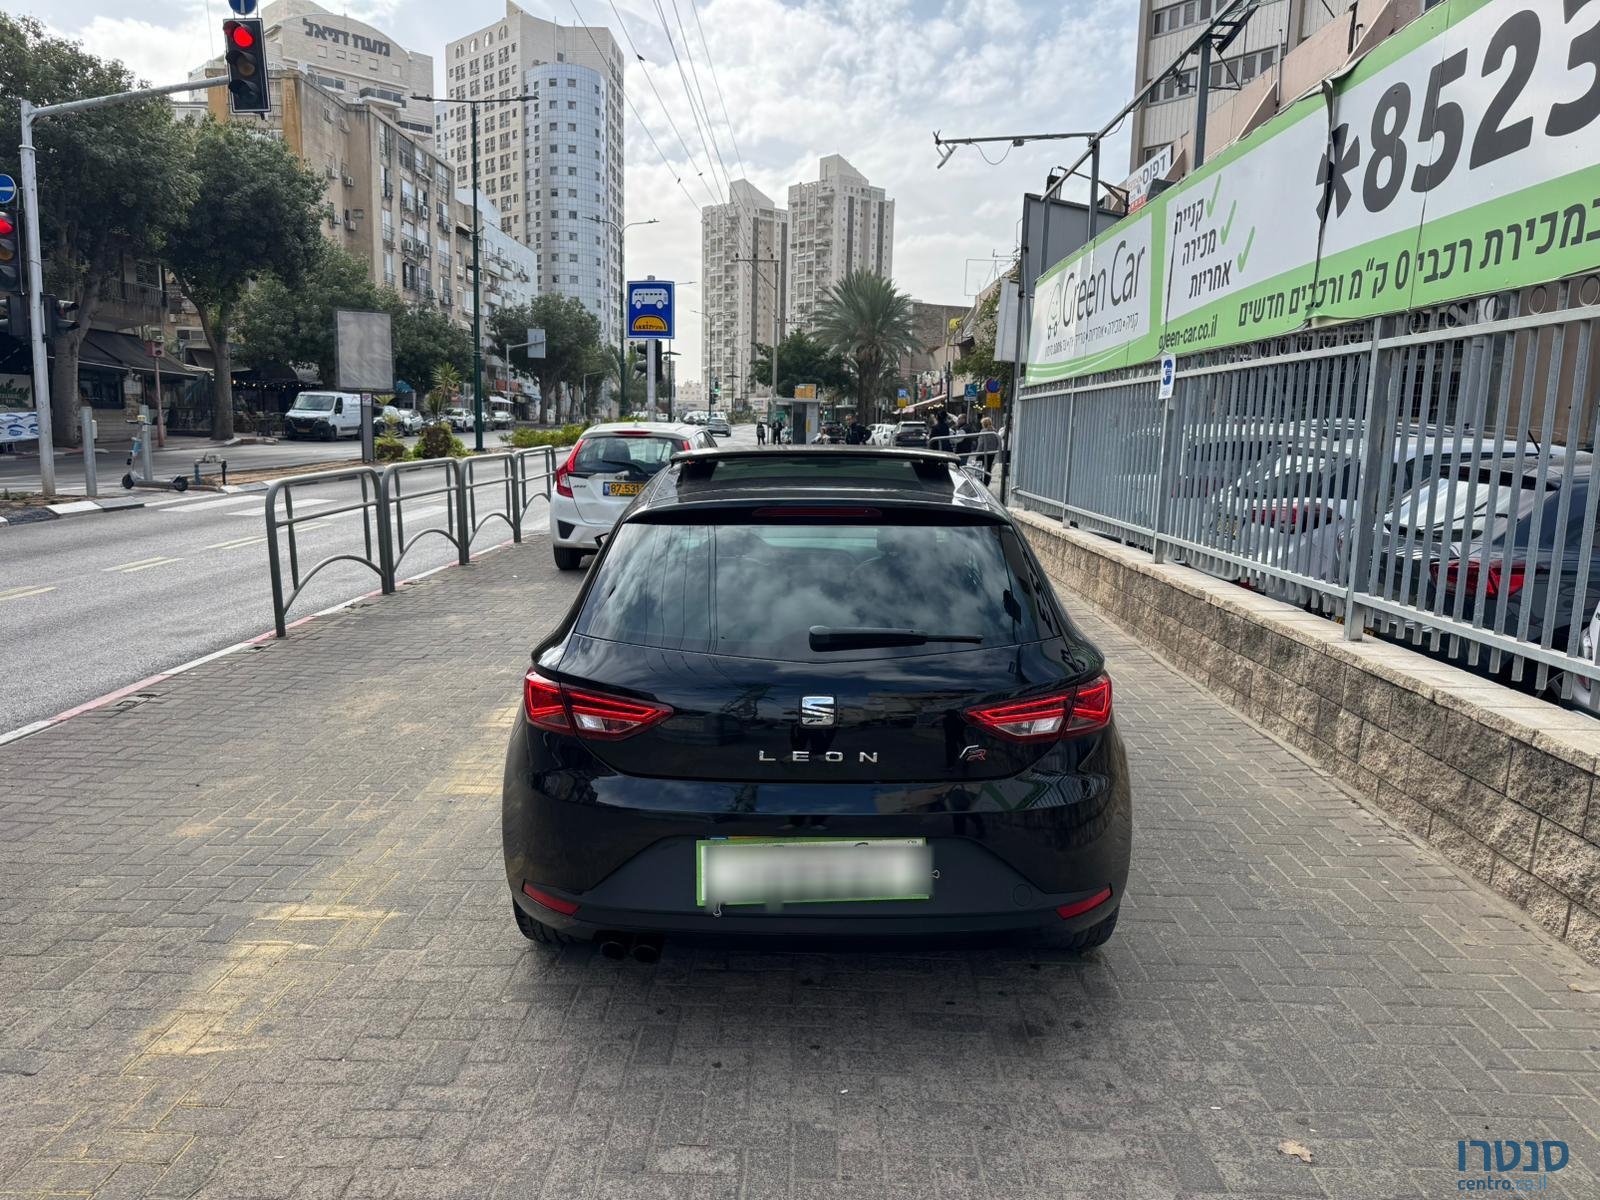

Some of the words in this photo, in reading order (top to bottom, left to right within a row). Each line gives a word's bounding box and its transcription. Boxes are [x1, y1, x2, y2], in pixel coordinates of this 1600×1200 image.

[1142, 154, 1167, 185] דפוס
[1182, 228, 1217, 266] מכירה
[1417, 238, 1473, 284] רכבי
[1063, 268, 1106, 327] Green
[1110, 239, 1146, 307] Car
[1188, 259, 1233, 299] אחריות
[1395, 250, 1410, 290] 0
[1238, 292, 1285, 327] חדשים
[758, 750, 879, 763] LEON
